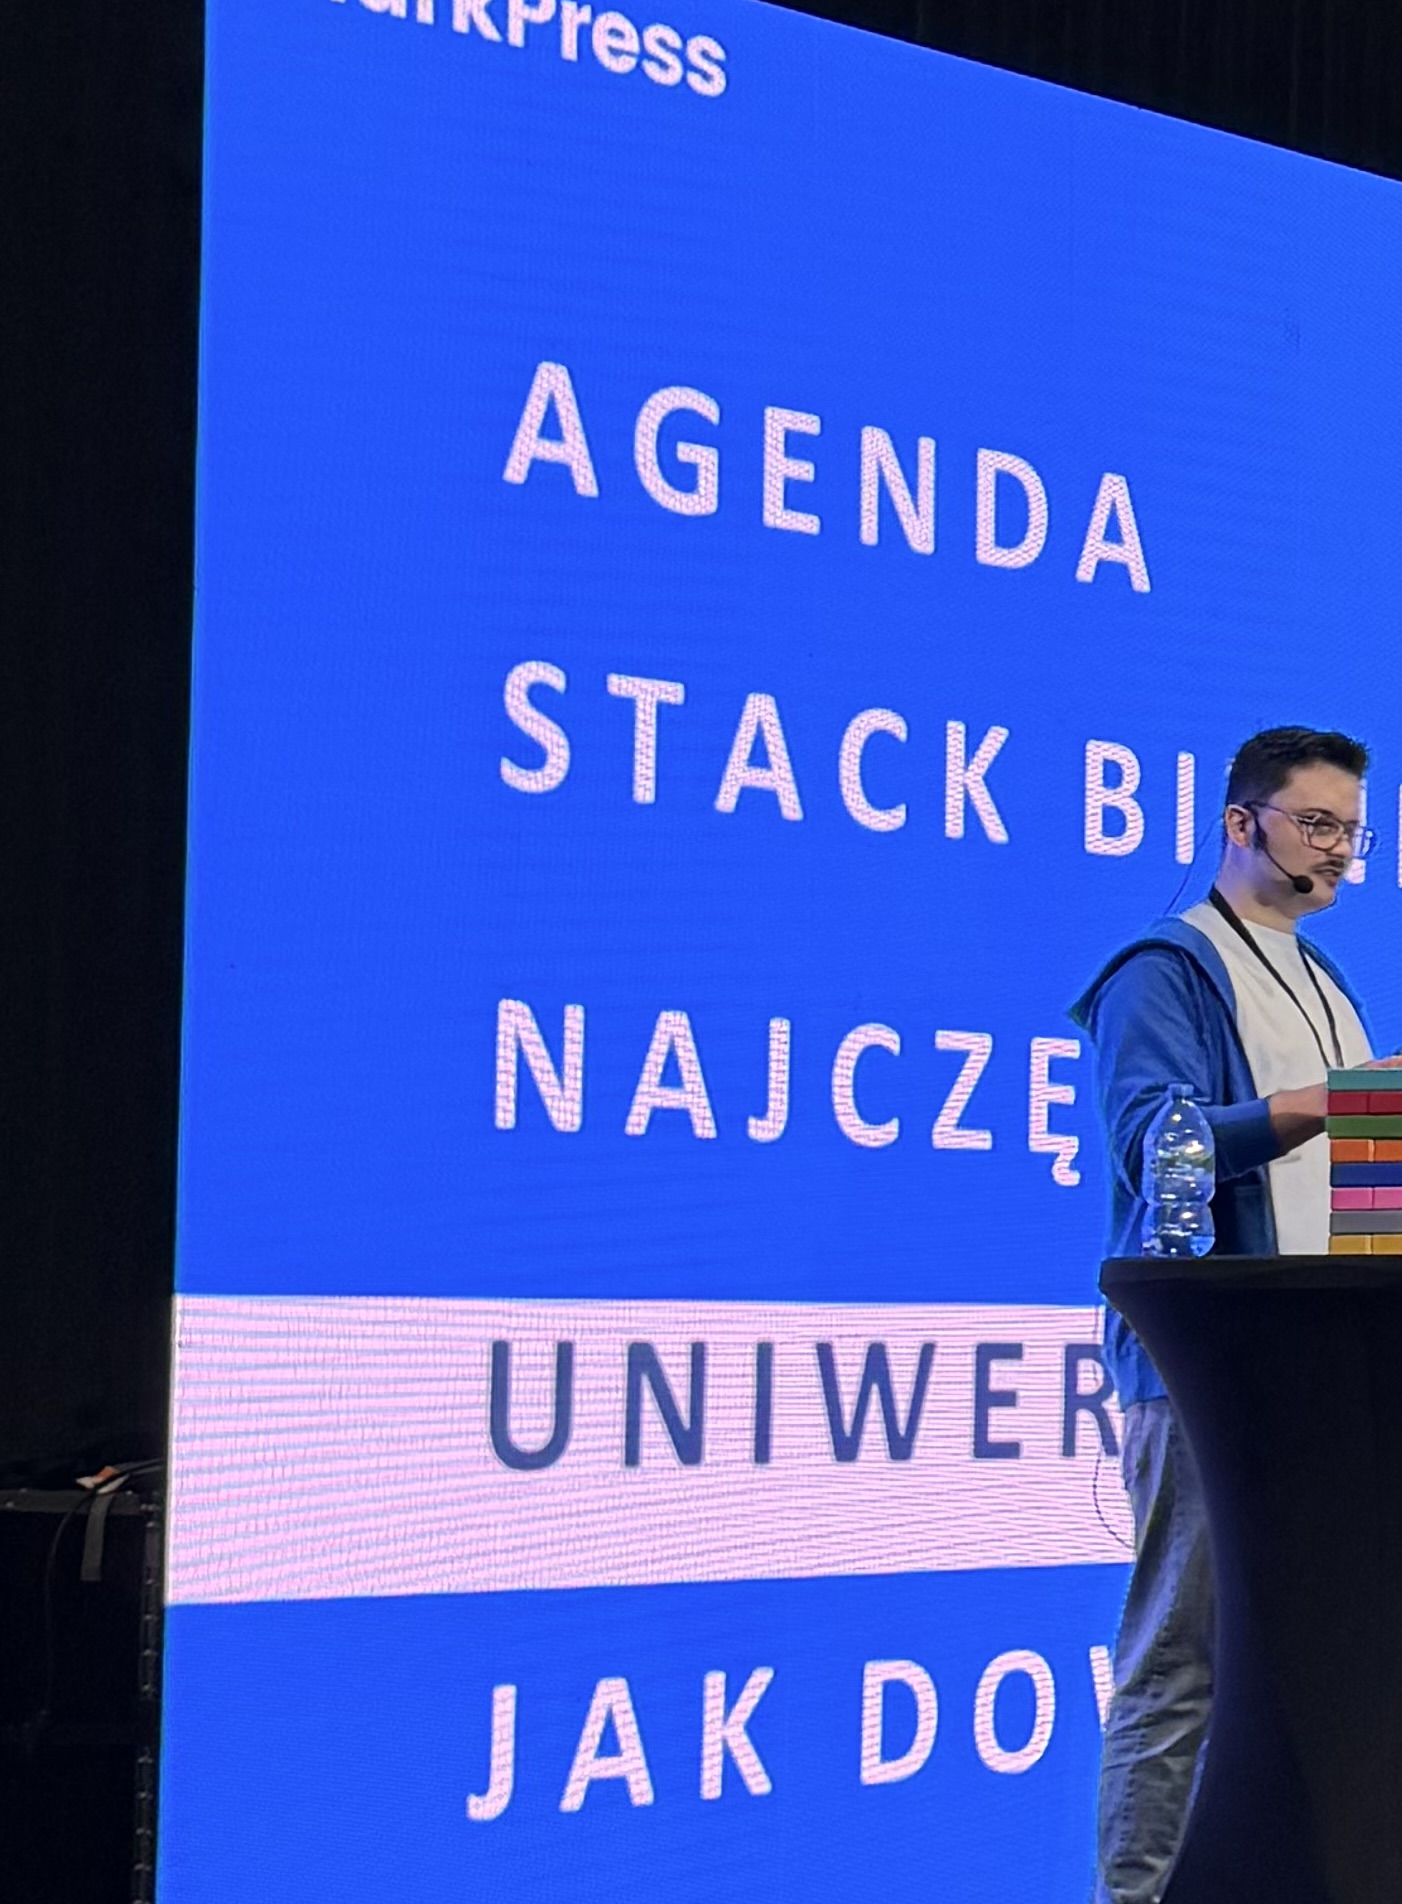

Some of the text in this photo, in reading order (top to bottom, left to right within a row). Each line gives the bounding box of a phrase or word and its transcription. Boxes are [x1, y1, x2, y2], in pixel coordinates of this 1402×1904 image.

[502, 361, 1152, 594] AGENDA
[499, 659, 1010, 844] STACK
[494, 998, 1082, 1187] NAJCZĘ
[488, 1339, 1121, 1472] UNIWER
[465, 1666, 775, 1822] JAK
